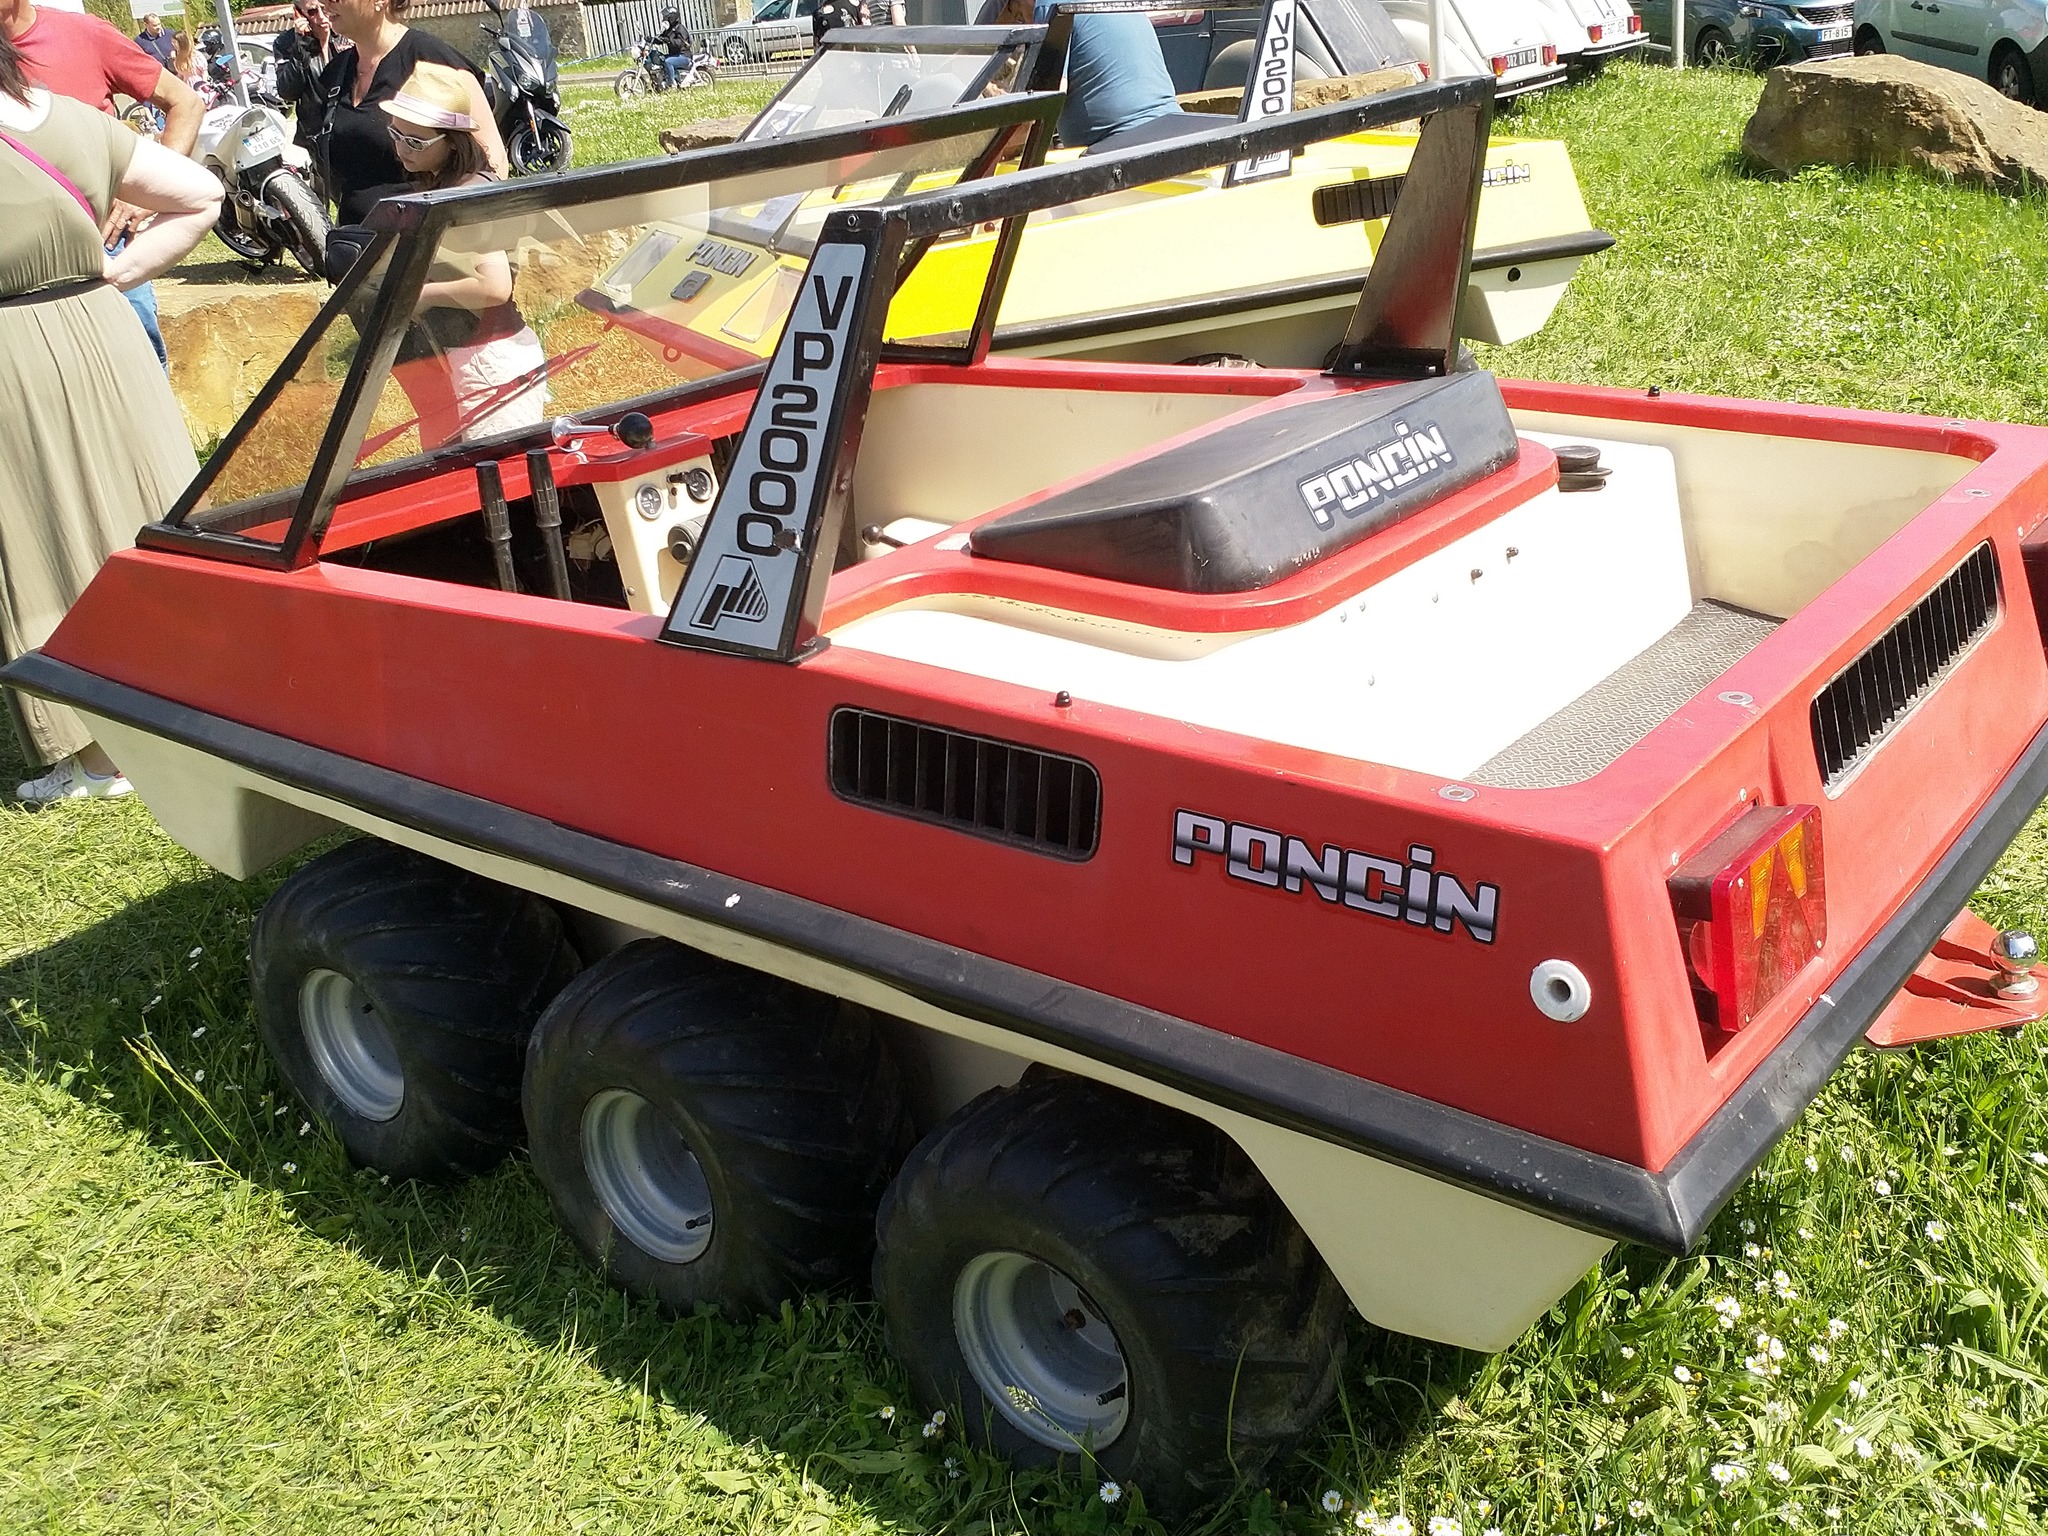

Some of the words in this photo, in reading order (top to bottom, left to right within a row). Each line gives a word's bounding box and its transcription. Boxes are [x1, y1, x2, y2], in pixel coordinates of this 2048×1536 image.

[1260, 12, 1292, 120] VP200
[686, 239, 760, 278] PONCIN
[738, 275, 854, 558] VP2000
